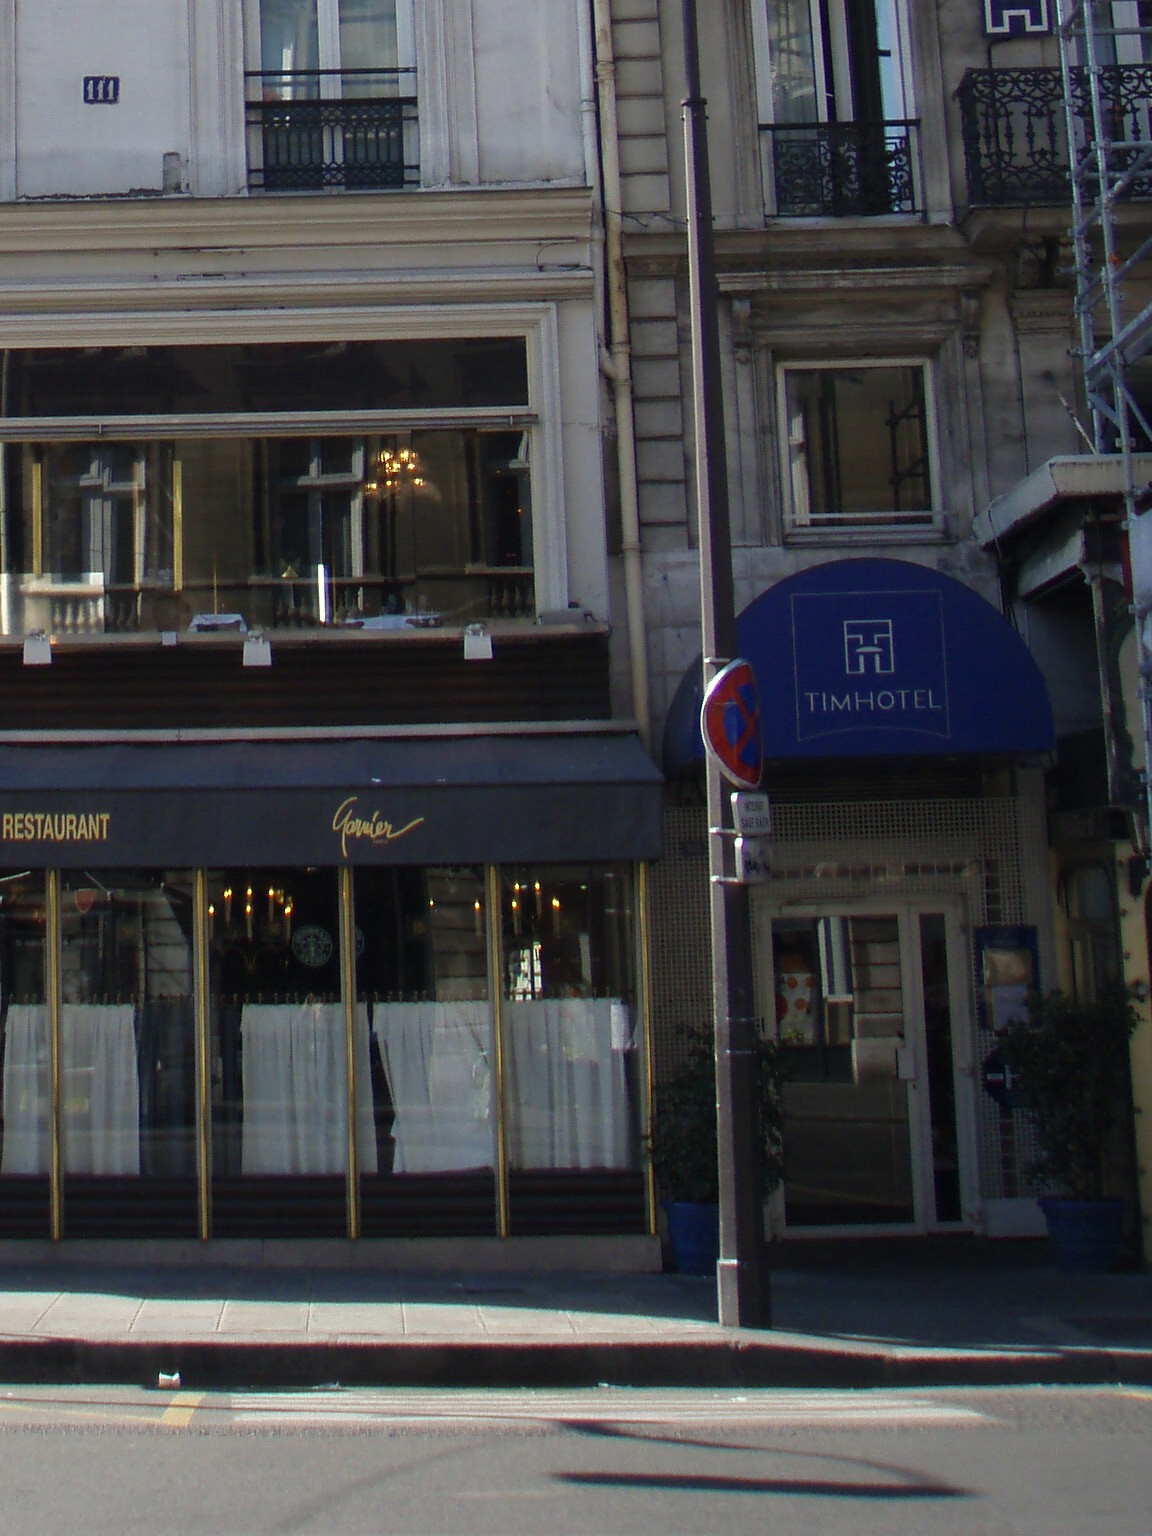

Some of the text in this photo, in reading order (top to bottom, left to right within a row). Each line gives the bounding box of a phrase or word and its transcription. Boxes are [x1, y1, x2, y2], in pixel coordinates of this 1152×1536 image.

[86, 79, 115, 101] 111
[804, 688, 943, 713] TIMHOTEL
[2, 812, 111, 840] RESTAURANT
[332, 796, 425, 858] Garnier
